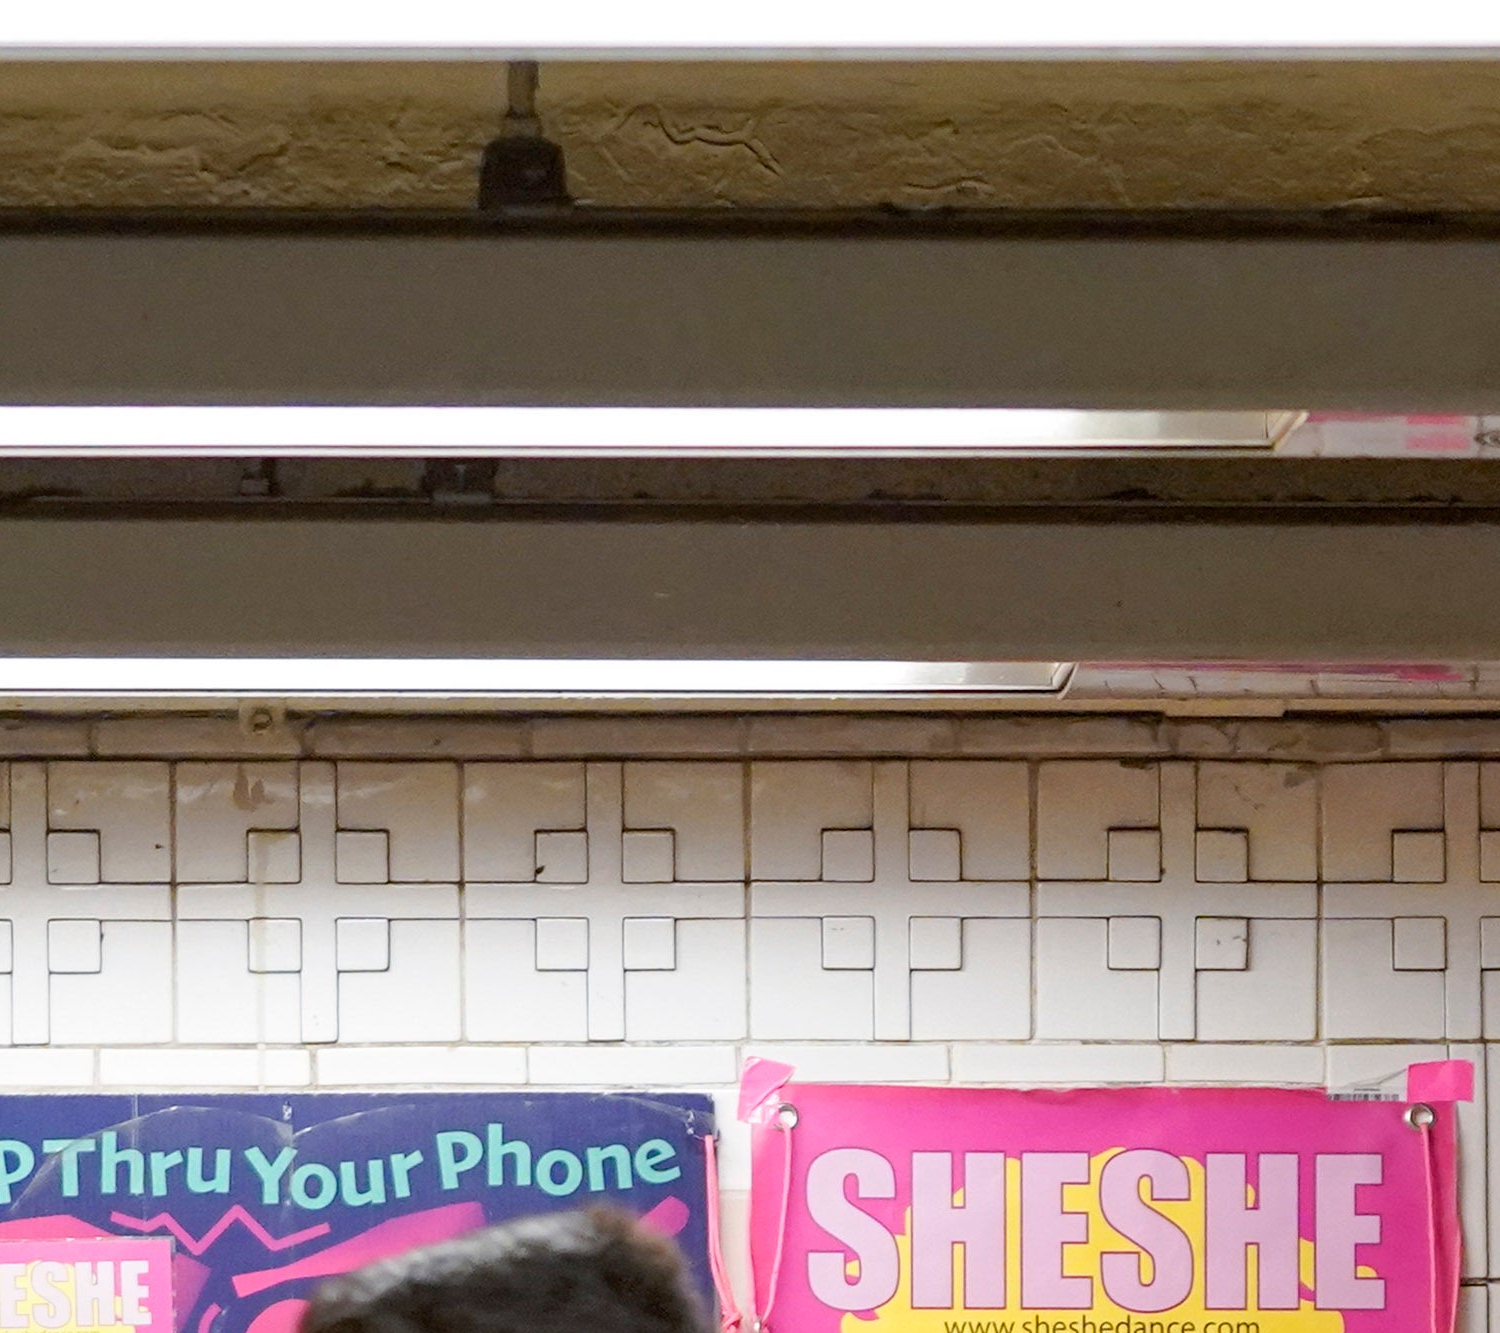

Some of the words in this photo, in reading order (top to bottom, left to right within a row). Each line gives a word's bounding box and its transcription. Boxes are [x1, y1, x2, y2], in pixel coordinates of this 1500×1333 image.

[42, 1130, 231, 1198] Thru
[244, 1145, 425, 1212] Your
[435, 1123, 682, 1198] Phone
[804, 1147, 1387, 1313] SHESHE
